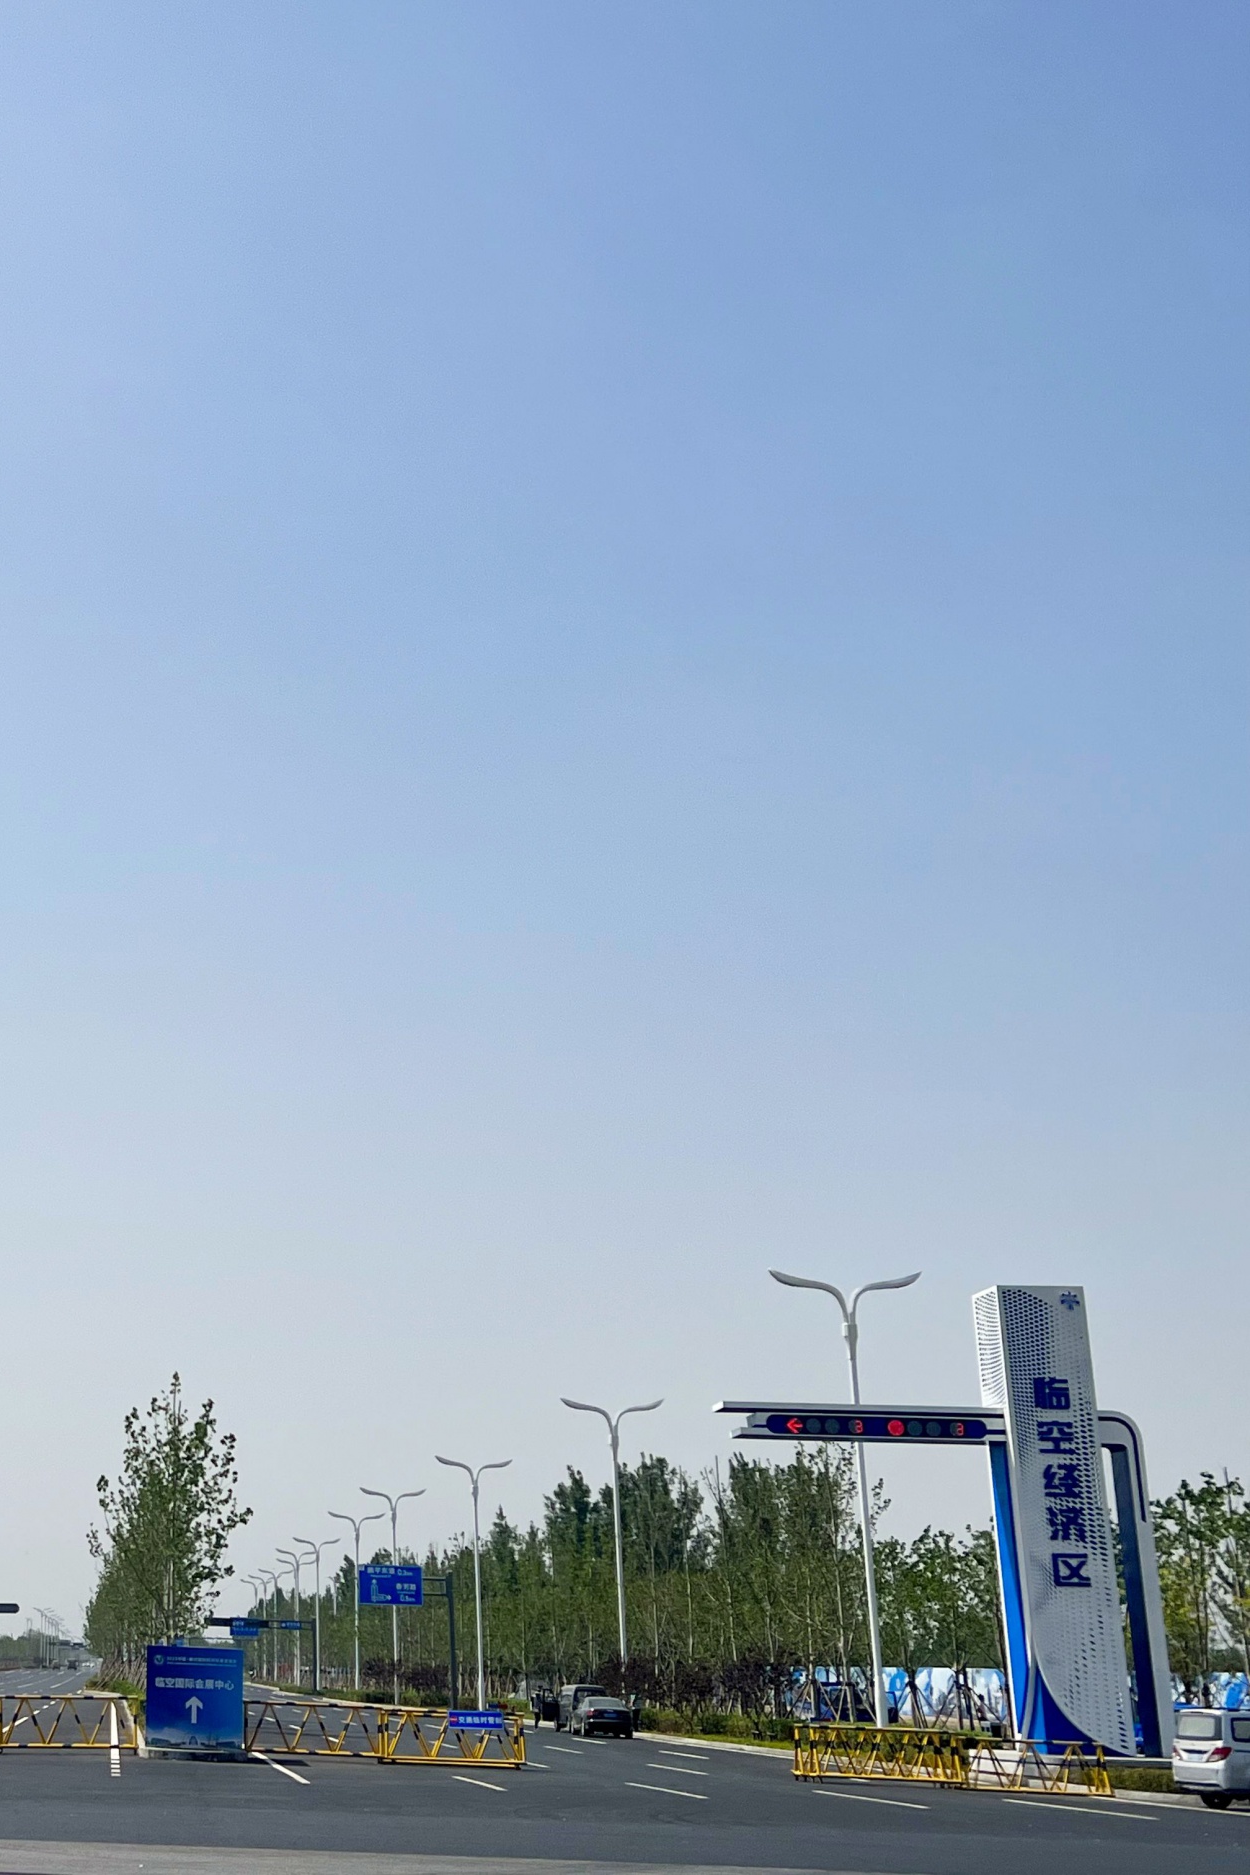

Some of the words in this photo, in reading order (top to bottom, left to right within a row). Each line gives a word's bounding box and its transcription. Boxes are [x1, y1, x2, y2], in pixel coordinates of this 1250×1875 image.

[1033, 1377, 1092, 1587] 临空经济区
[155, 1677, 235, 1690] 临空国际会展中心
